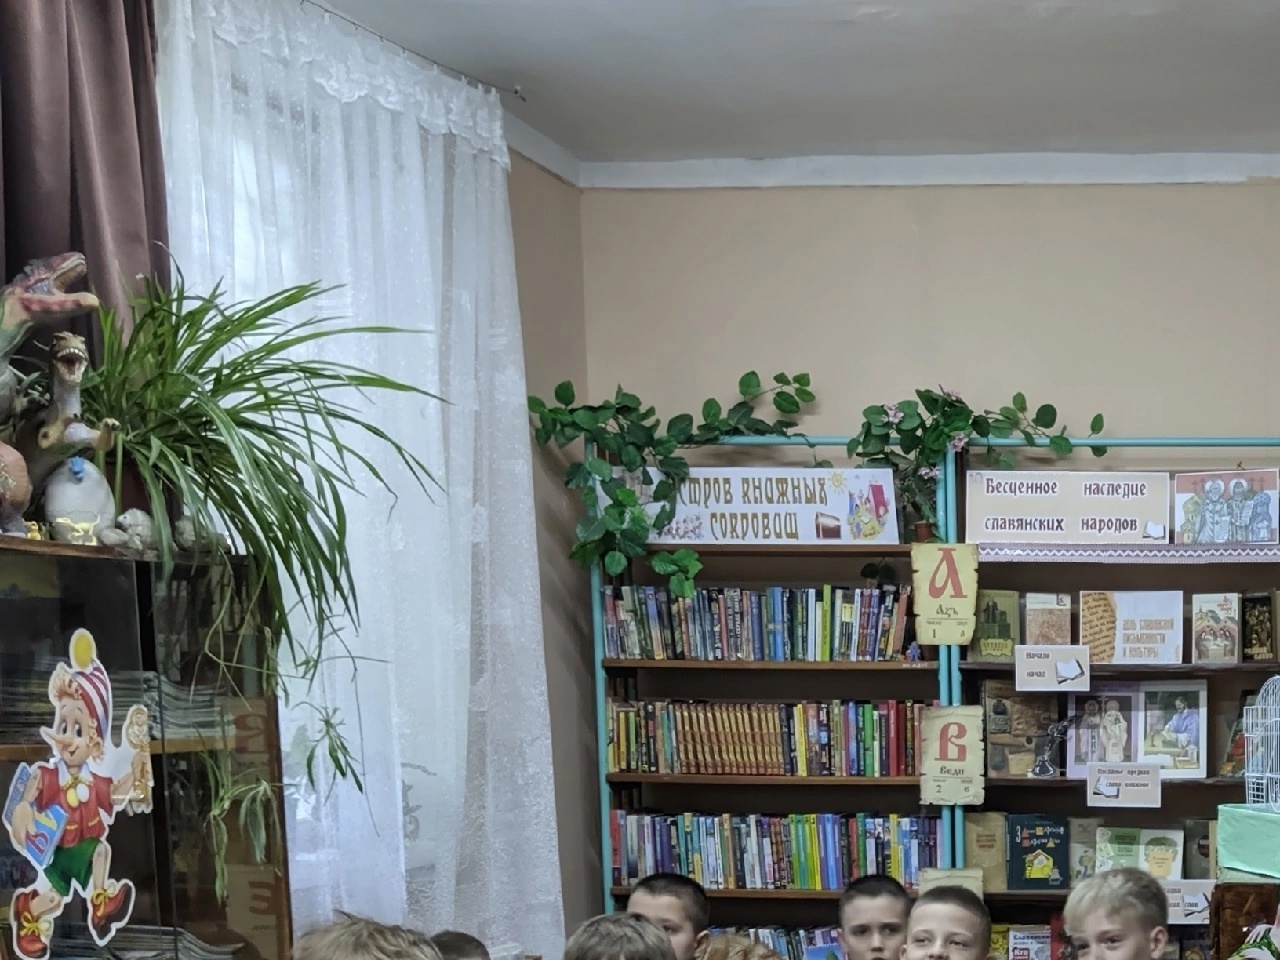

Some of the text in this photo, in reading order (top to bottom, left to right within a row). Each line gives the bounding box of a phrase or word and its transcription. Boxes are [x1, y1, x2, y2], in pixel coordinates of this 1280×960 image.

[678, 477, 733, 508] СТРОВ
[985, 478, 1147, 499] Бесценное наследие
[985, 516, 1138, 534] славянских народов
